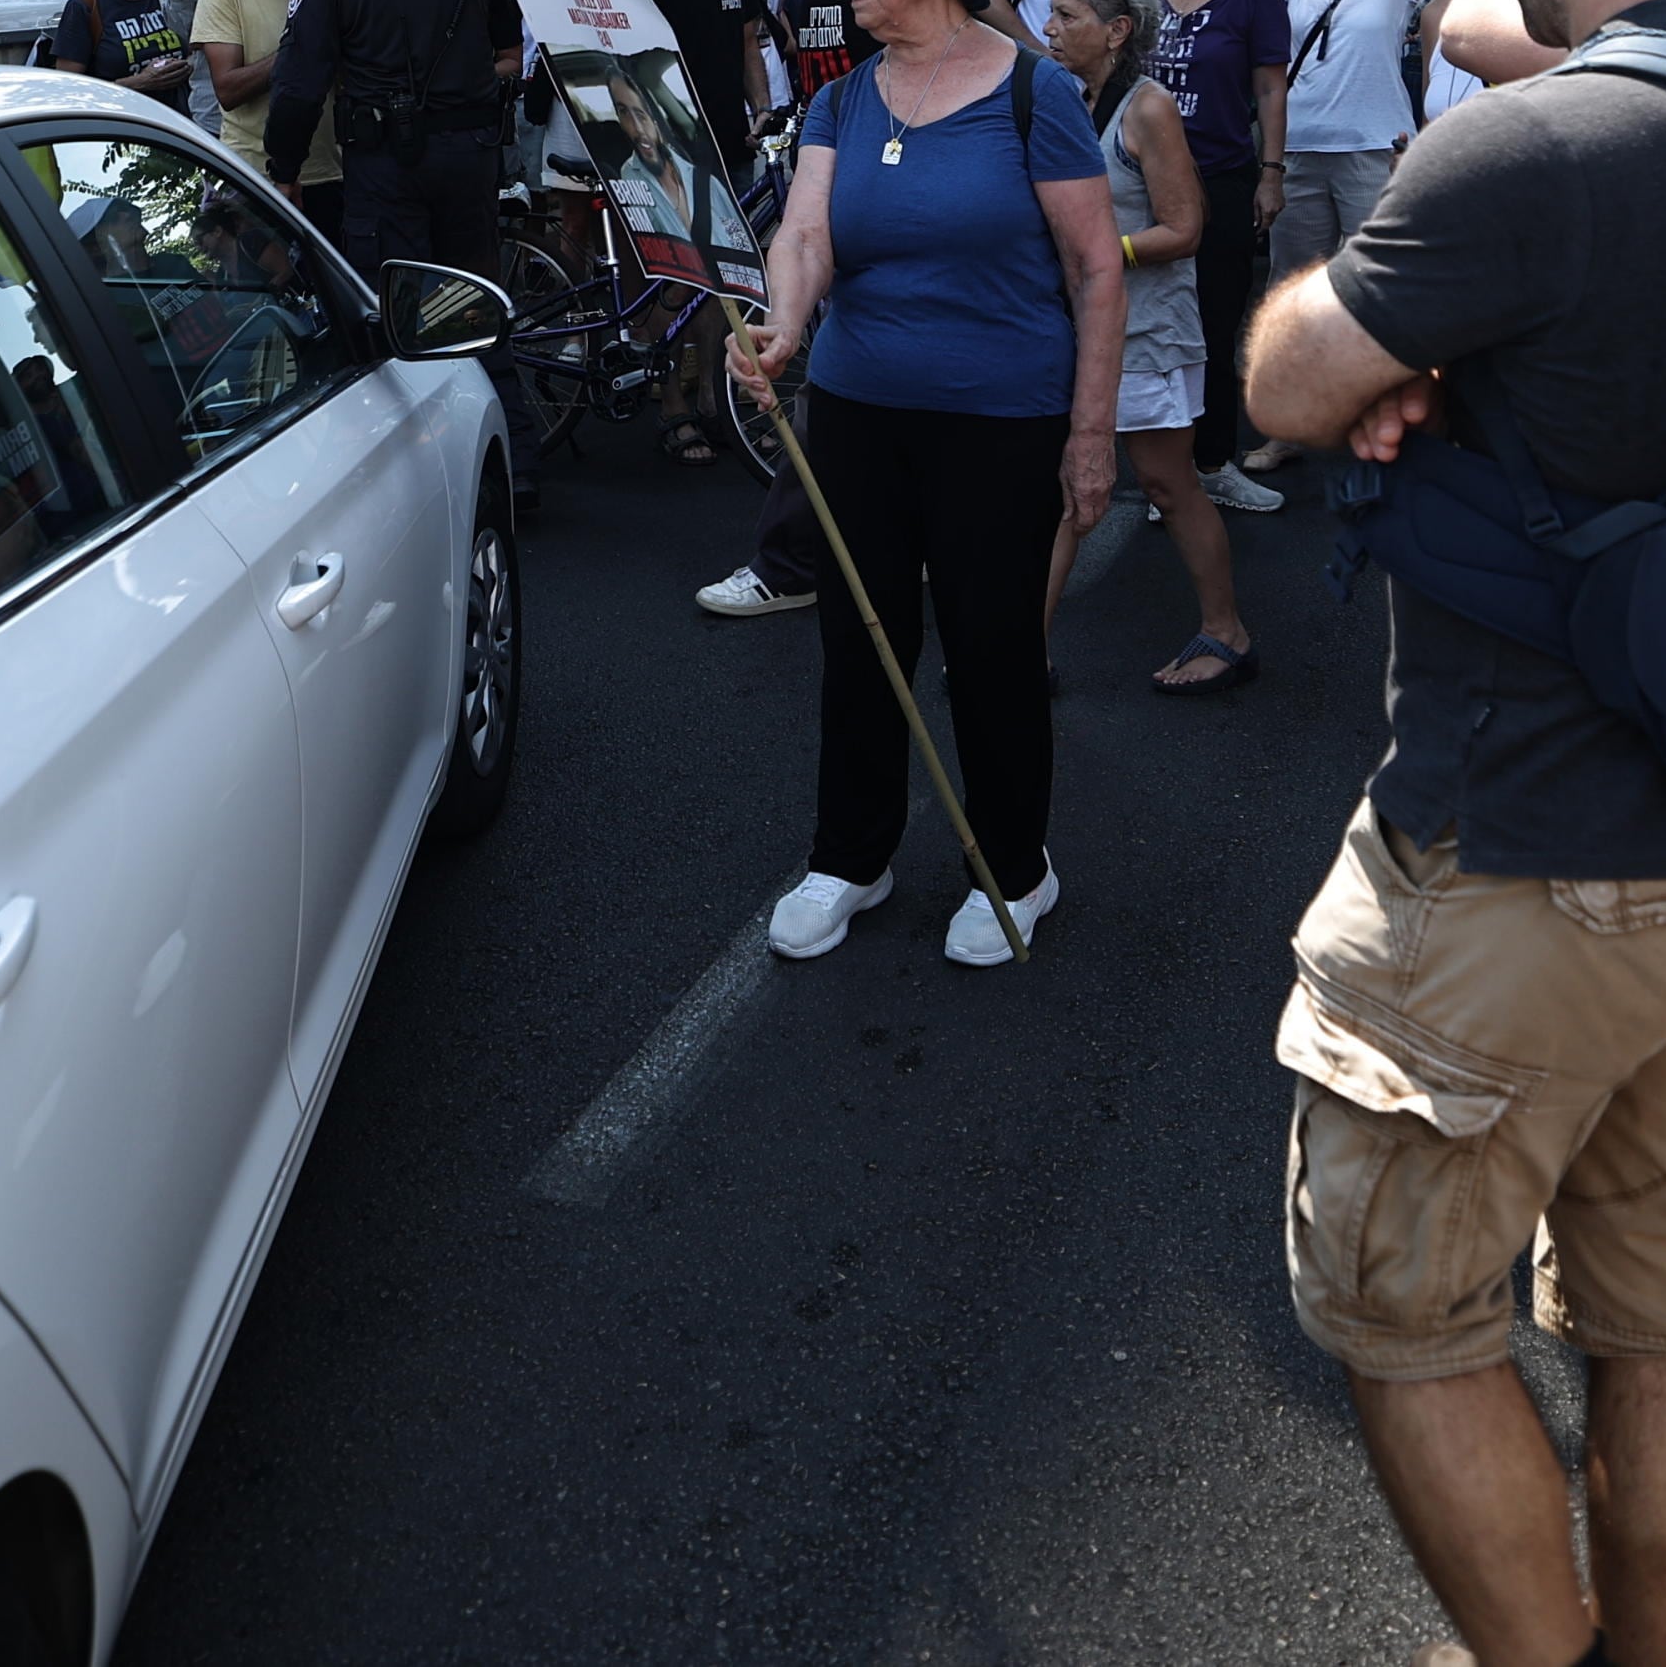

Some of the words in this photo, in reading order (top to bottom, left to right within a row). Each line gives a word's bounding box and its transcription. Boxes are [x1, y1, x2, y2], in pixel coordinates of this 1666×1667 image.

[122, 29, 182, 64] עדיין
[609, 179, 655, 207] BRING
[621, 206, 656, 234] HIM
